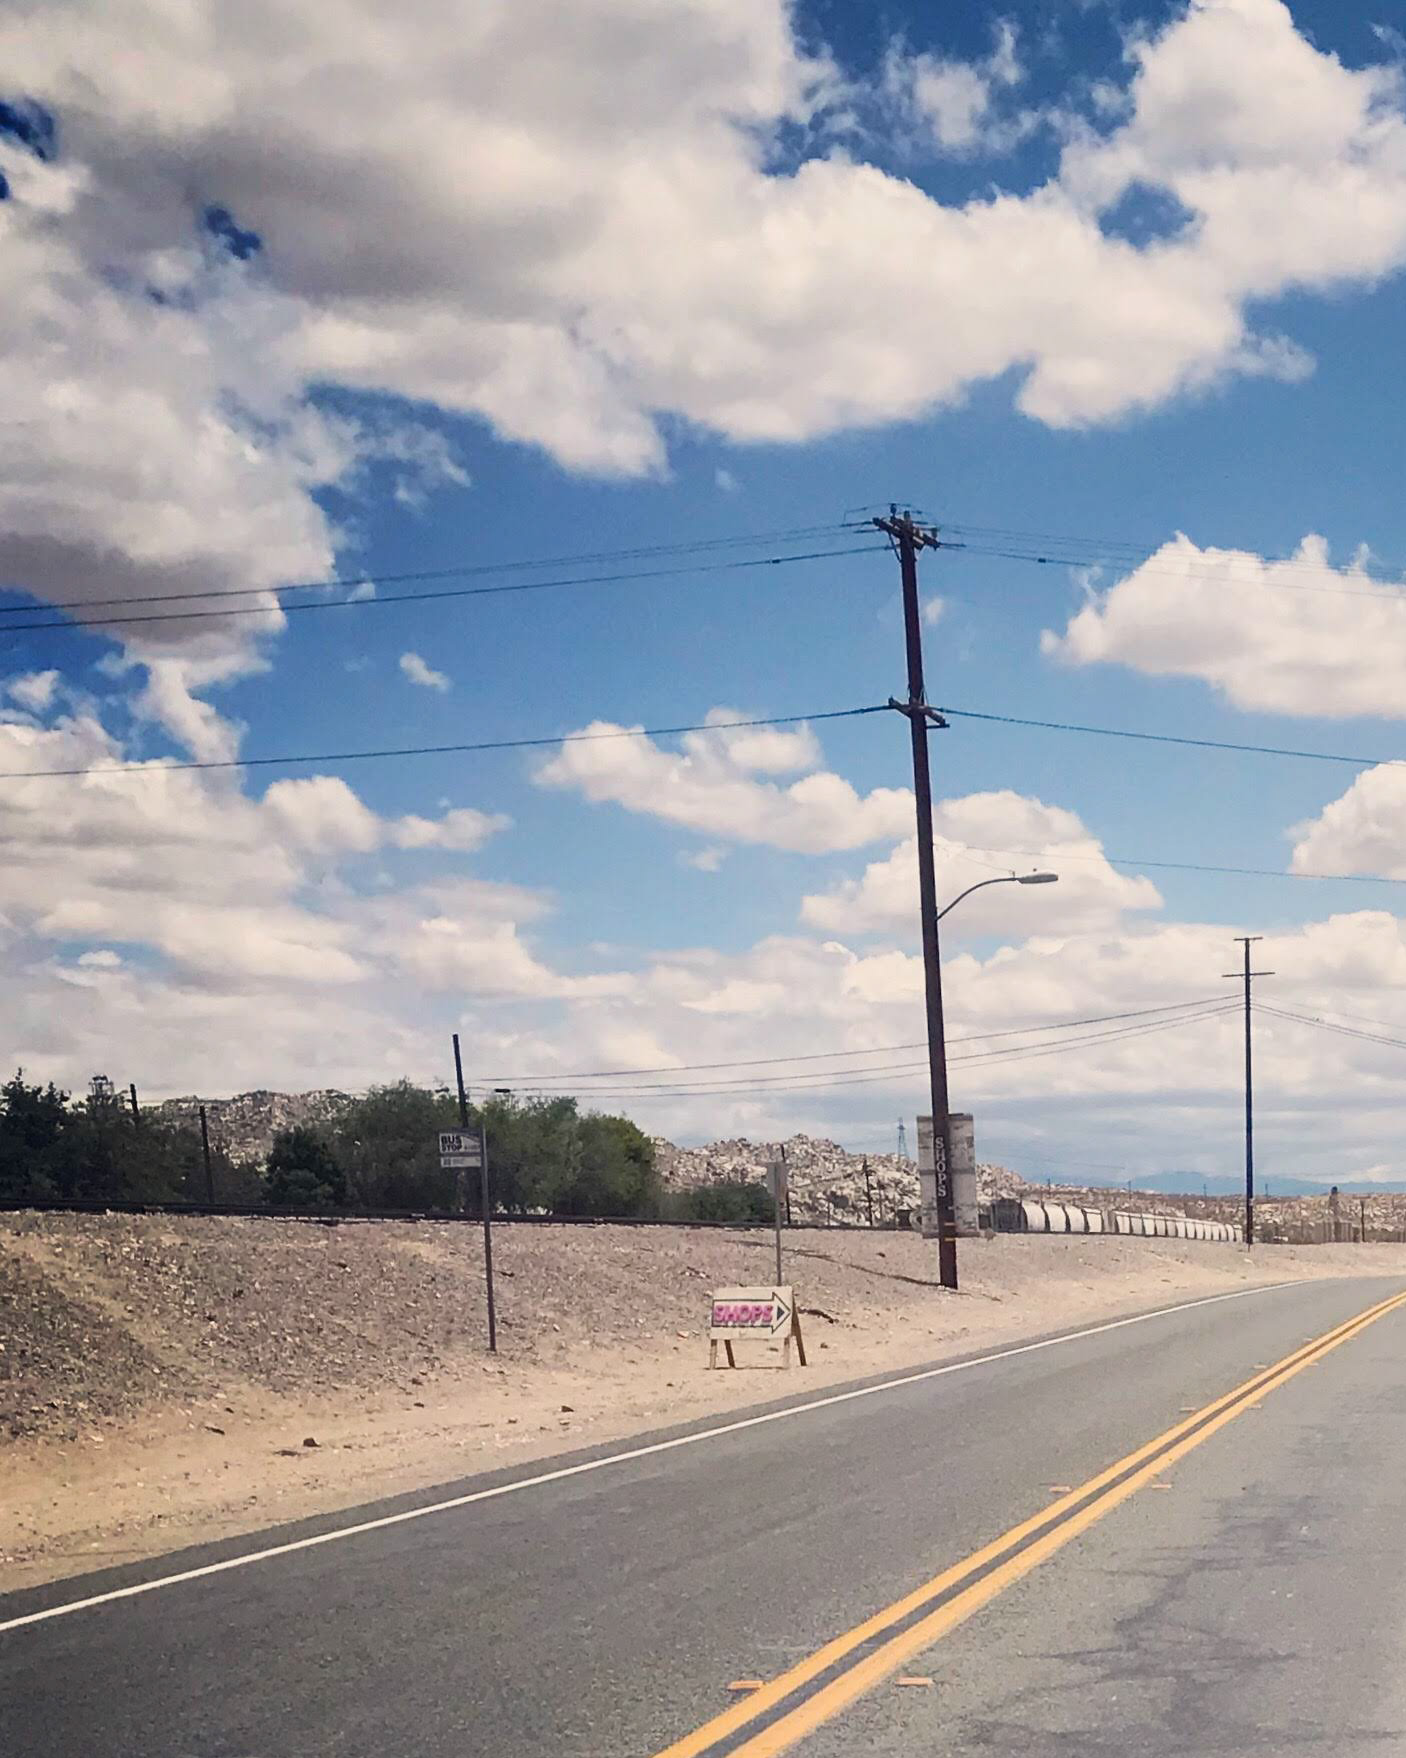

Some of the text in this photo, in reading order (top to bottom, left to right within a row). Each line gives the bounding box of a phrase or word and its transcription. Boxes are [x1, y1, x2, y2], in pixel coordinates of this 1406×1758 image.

[441, 1135, 461, 1144] BUS
[935, 1136, 947, 1197] SHOPS
[714, 1304, 774, 1324] SHOPS
